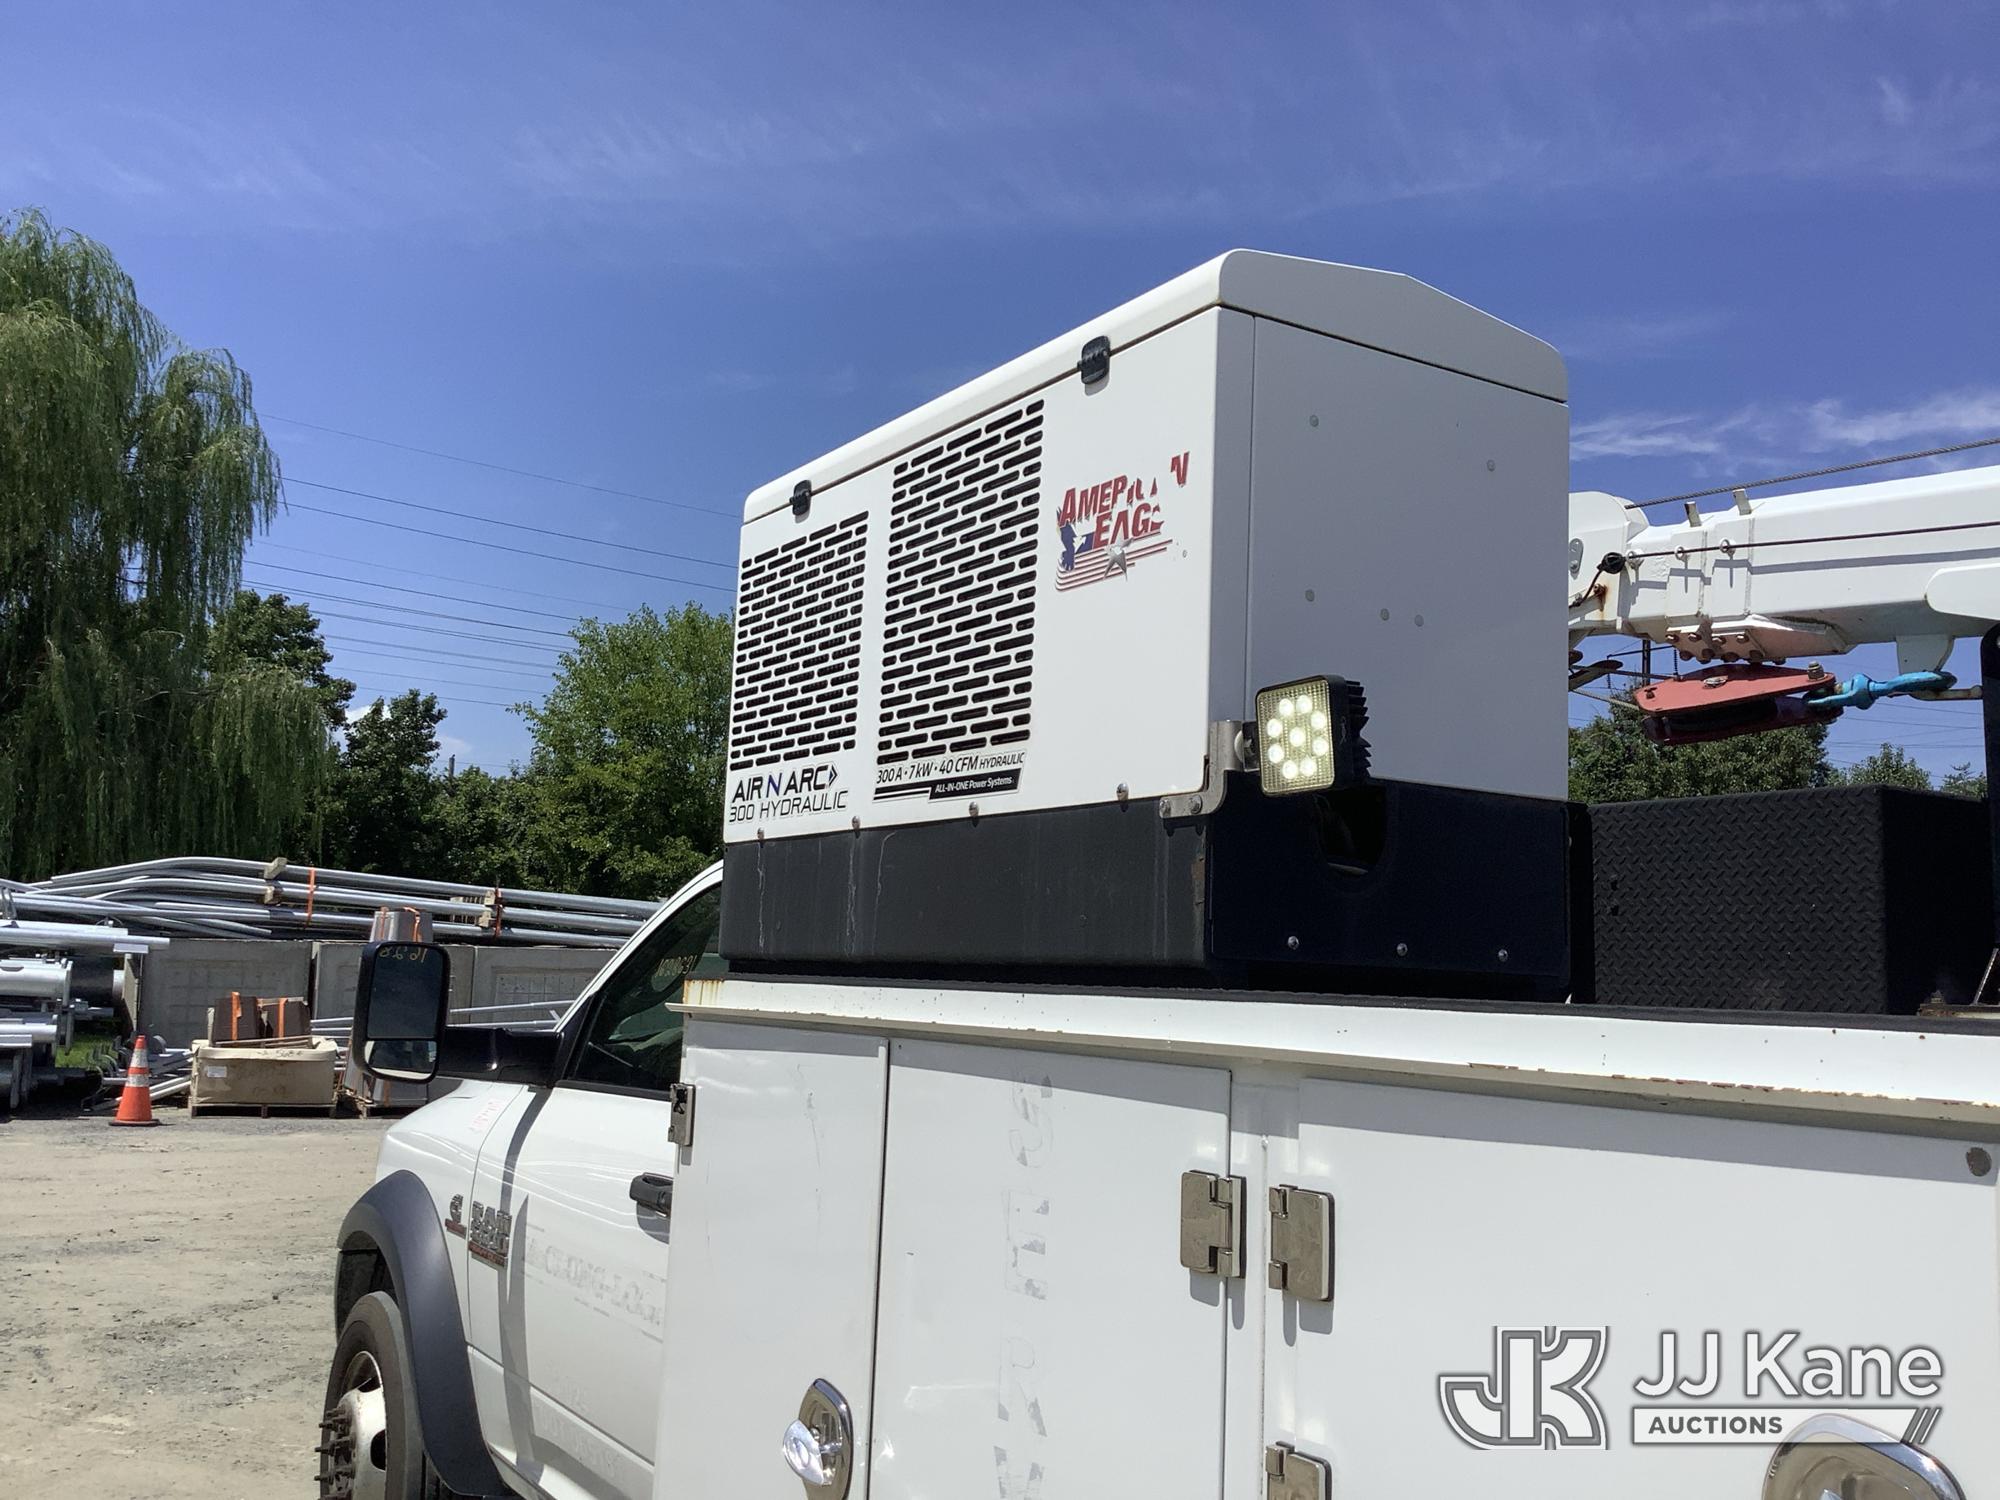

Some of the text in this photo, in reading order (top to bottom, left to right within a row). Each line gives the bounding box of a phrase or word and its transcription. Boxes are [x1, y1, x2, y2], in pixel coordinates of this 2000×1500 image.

[732, 765, 829, 803] AIR N ARC
[876, 768, 895, 784] 300
[915, 762, 934, 778] kW
[939, 759, 954, 774] 40
[955, 755, 979, 772] CFM
[980, 752, 1025, 769] HYDRAULIC
[935, 777, 1013, 793] ALL-IN-ONE Power Systems
[729, 790, 848, 823] 300 HYDRAULIC
